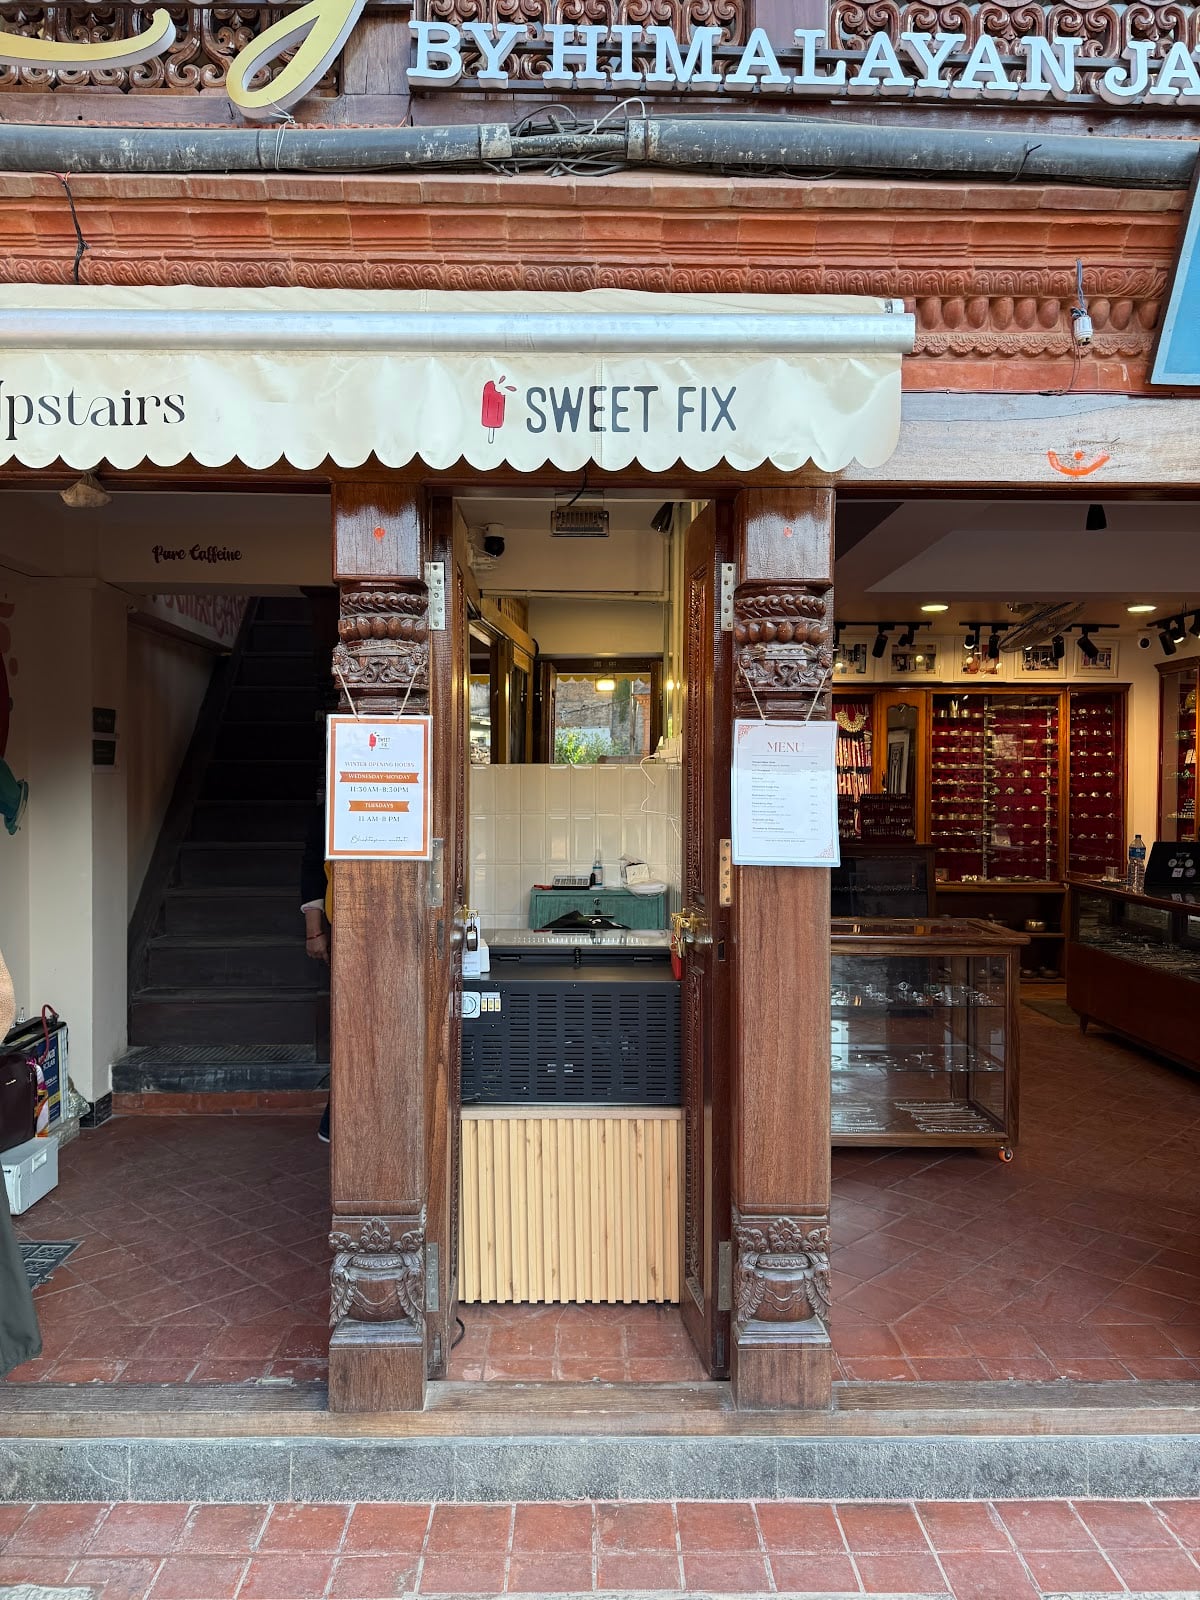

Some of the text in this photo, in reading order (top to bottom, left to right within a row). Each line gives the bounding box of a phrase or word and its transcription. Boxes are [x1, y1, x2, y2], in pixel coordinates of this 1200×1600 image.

[406, 20, 528, 82] BY
[543, 24, 1084, 94] HIMALAYAN
[0, 380, 186, 440] pstairs
[526, 385, 737, 434] SWEET FIX
[152, 543, 242, 564] Pure Caffeine
[767, 741, 805, 753] MENU
